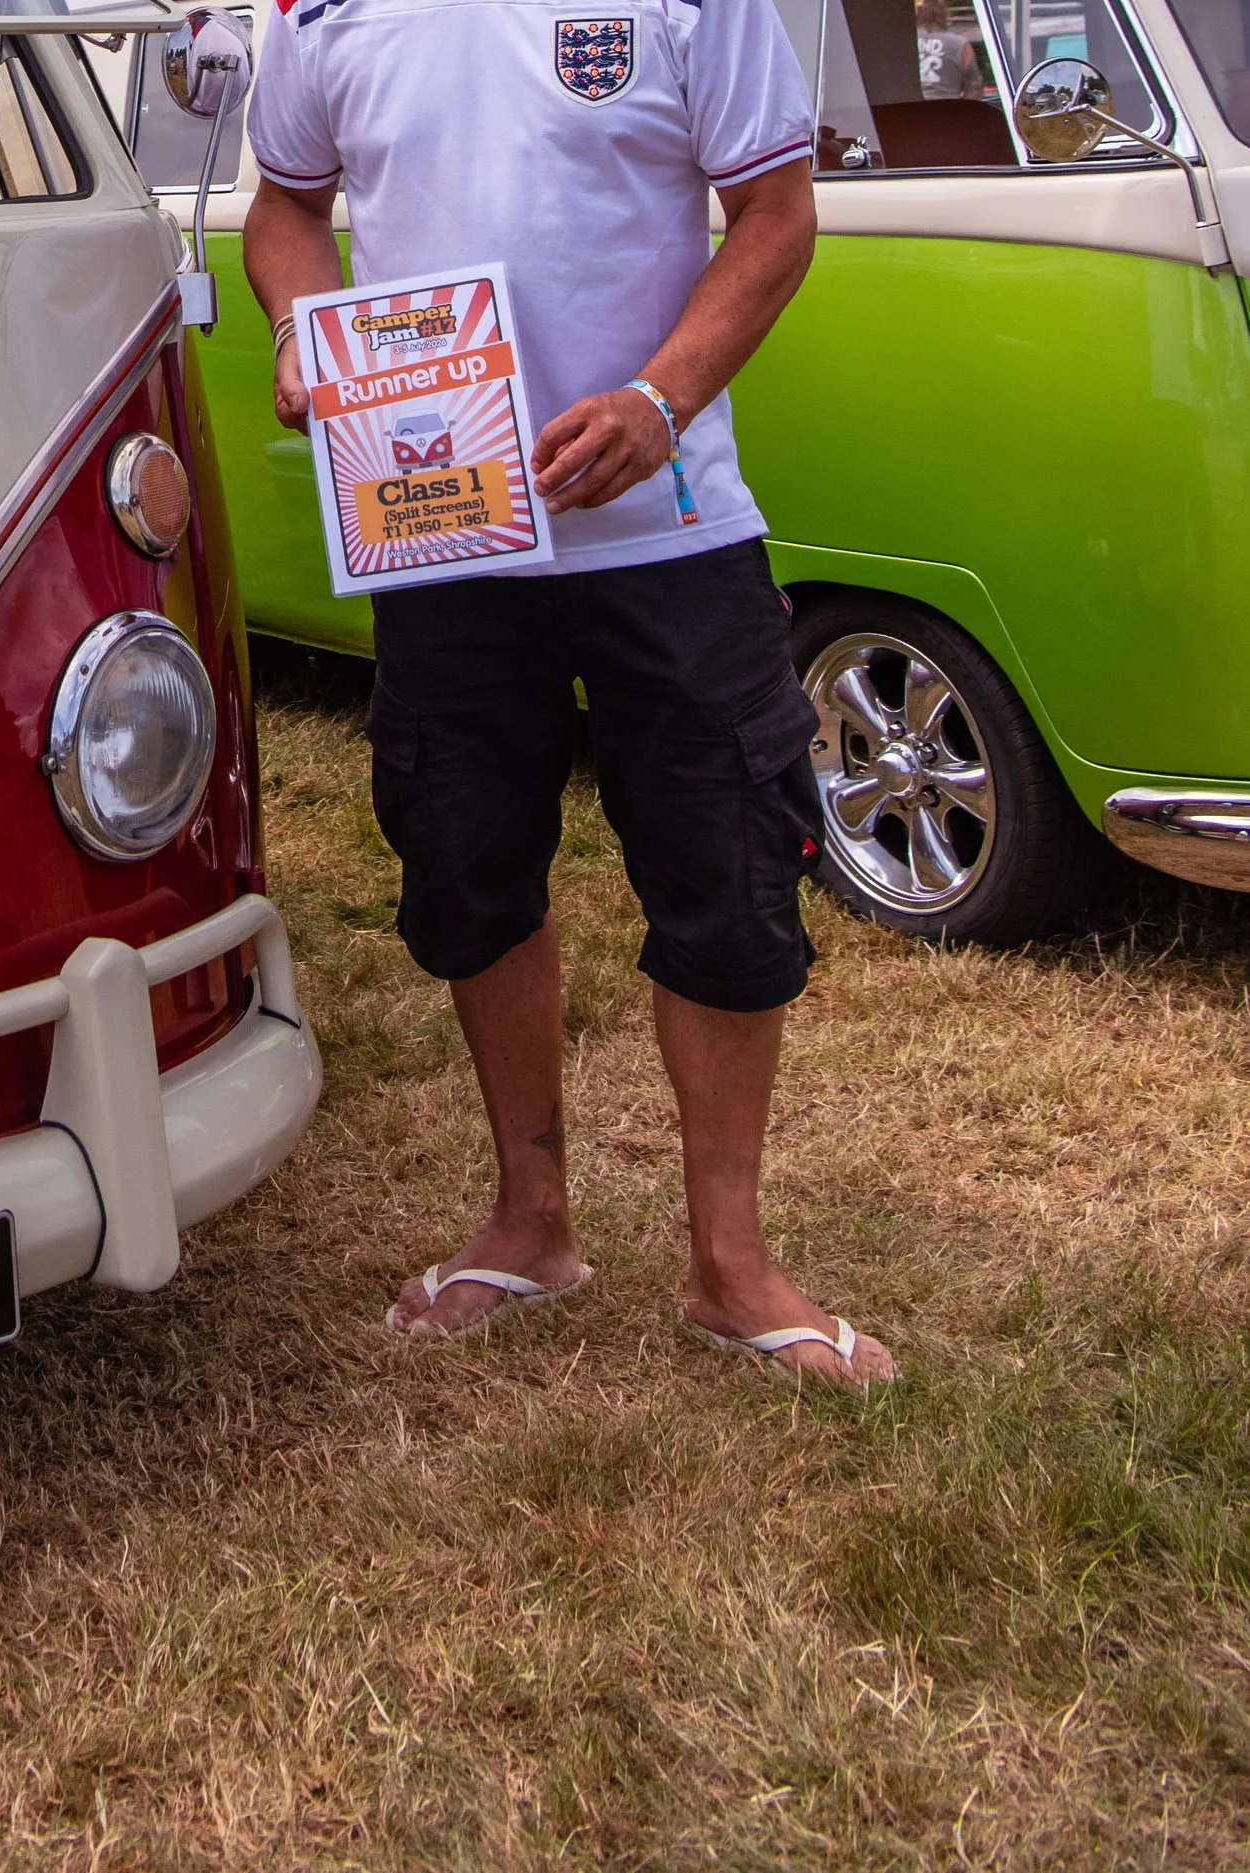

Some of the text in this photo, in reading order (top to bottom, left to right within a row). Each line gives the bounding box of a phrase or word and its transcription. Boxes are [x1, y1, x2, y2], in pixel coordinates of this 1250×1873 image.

[352, 304, 452, 333] Camper
[369, 316, 456, 351] Jam #17
[409, 341, 425, 353] July
[337, 355, 487, 406] Runner up
[377, 468, 484, 506] Class 1
[383, 525, 402, 539] T1
[407, 519, 441, 535] 1950
[456, 511, 490, 527] 1967
[384, 496, 485, 525] (Split Screens)
[387, 536, 492, 559] Weston Park, Shropshire
